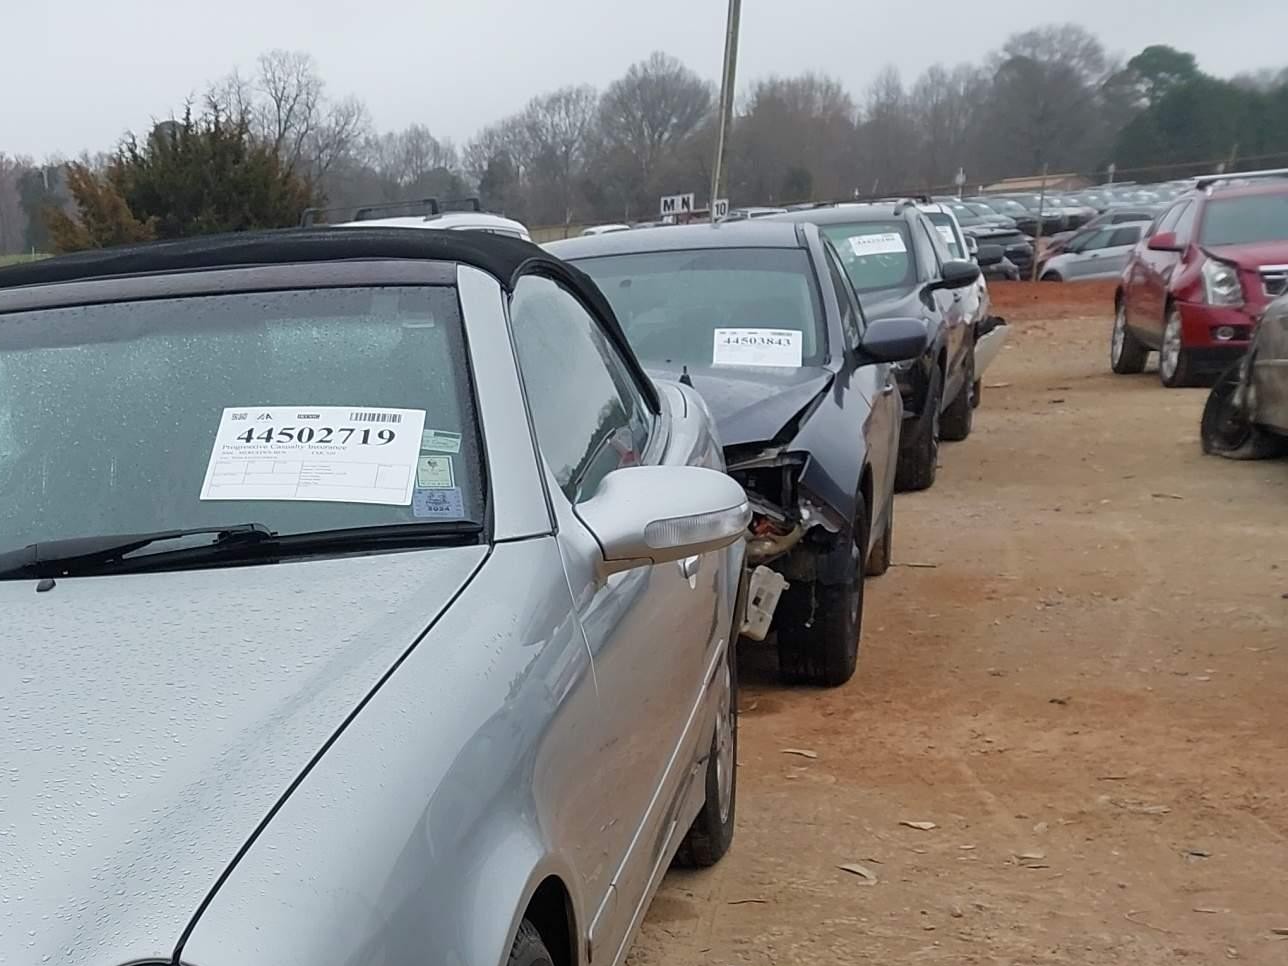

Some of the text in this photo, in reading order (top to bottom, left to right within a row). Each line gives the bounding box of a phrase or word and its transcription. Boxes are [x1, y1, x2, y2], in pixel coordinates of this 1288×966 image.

[663, 196, 691, 212] M N
[714, 202, 727, 216] 10
[723, 336, 791, 346] 44503843
[237, 426, 397, 446] 44502719
